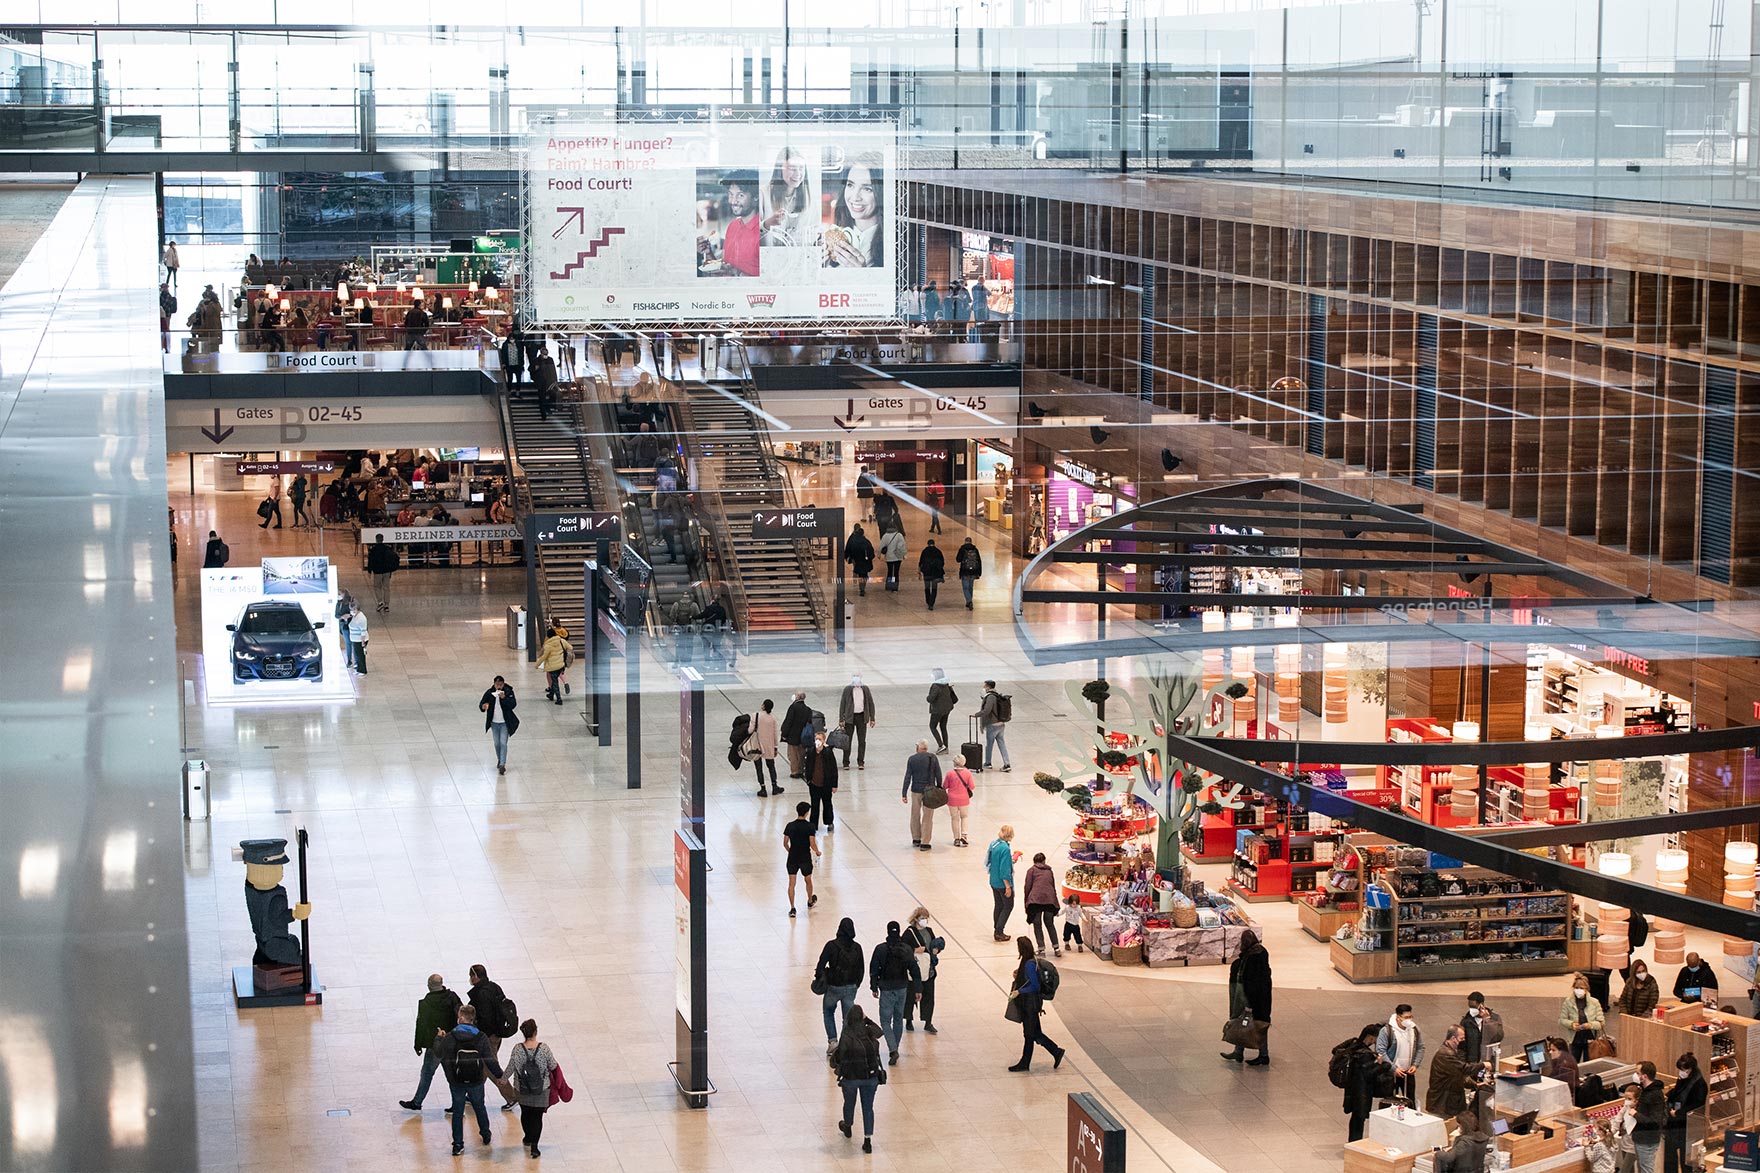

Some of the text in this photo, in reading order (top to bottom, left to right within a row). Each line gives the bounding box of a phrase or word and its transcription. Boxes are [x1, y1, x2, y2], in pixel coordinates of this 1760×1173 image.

[547, 137, 673, 153] Appetit? Hunger?
[547, 157, 656, 170] Faim? Hambre?
[548, 177, 632, 190] Food Court!
[691, 302, 719, 310] Nordic
[819, 293, 850, 308] BER
[633, 302, 680, 311] FISH&CHIPS
[838, 348, 906, 359] Food Court
[286, 355, 357, 366] Food Court
[869, 397, 904, 409] Gates
[908, 398, 932, 432] B
[236, 407, 273, 419] Gates
[279, 406, 307, 444] B
[559, 516, 577, 524] Food
[797, 512, 814, 520] Food
[556, 525, 578, 533] Court
[796, 520, 817, 528] Court
[395, 530, 454, 540] BERLINER
[1603, 645, 1627, 667] DUTY
[1627, 654, 1649, 676] FREE
[1379, 795, 1395, 803] 30%
